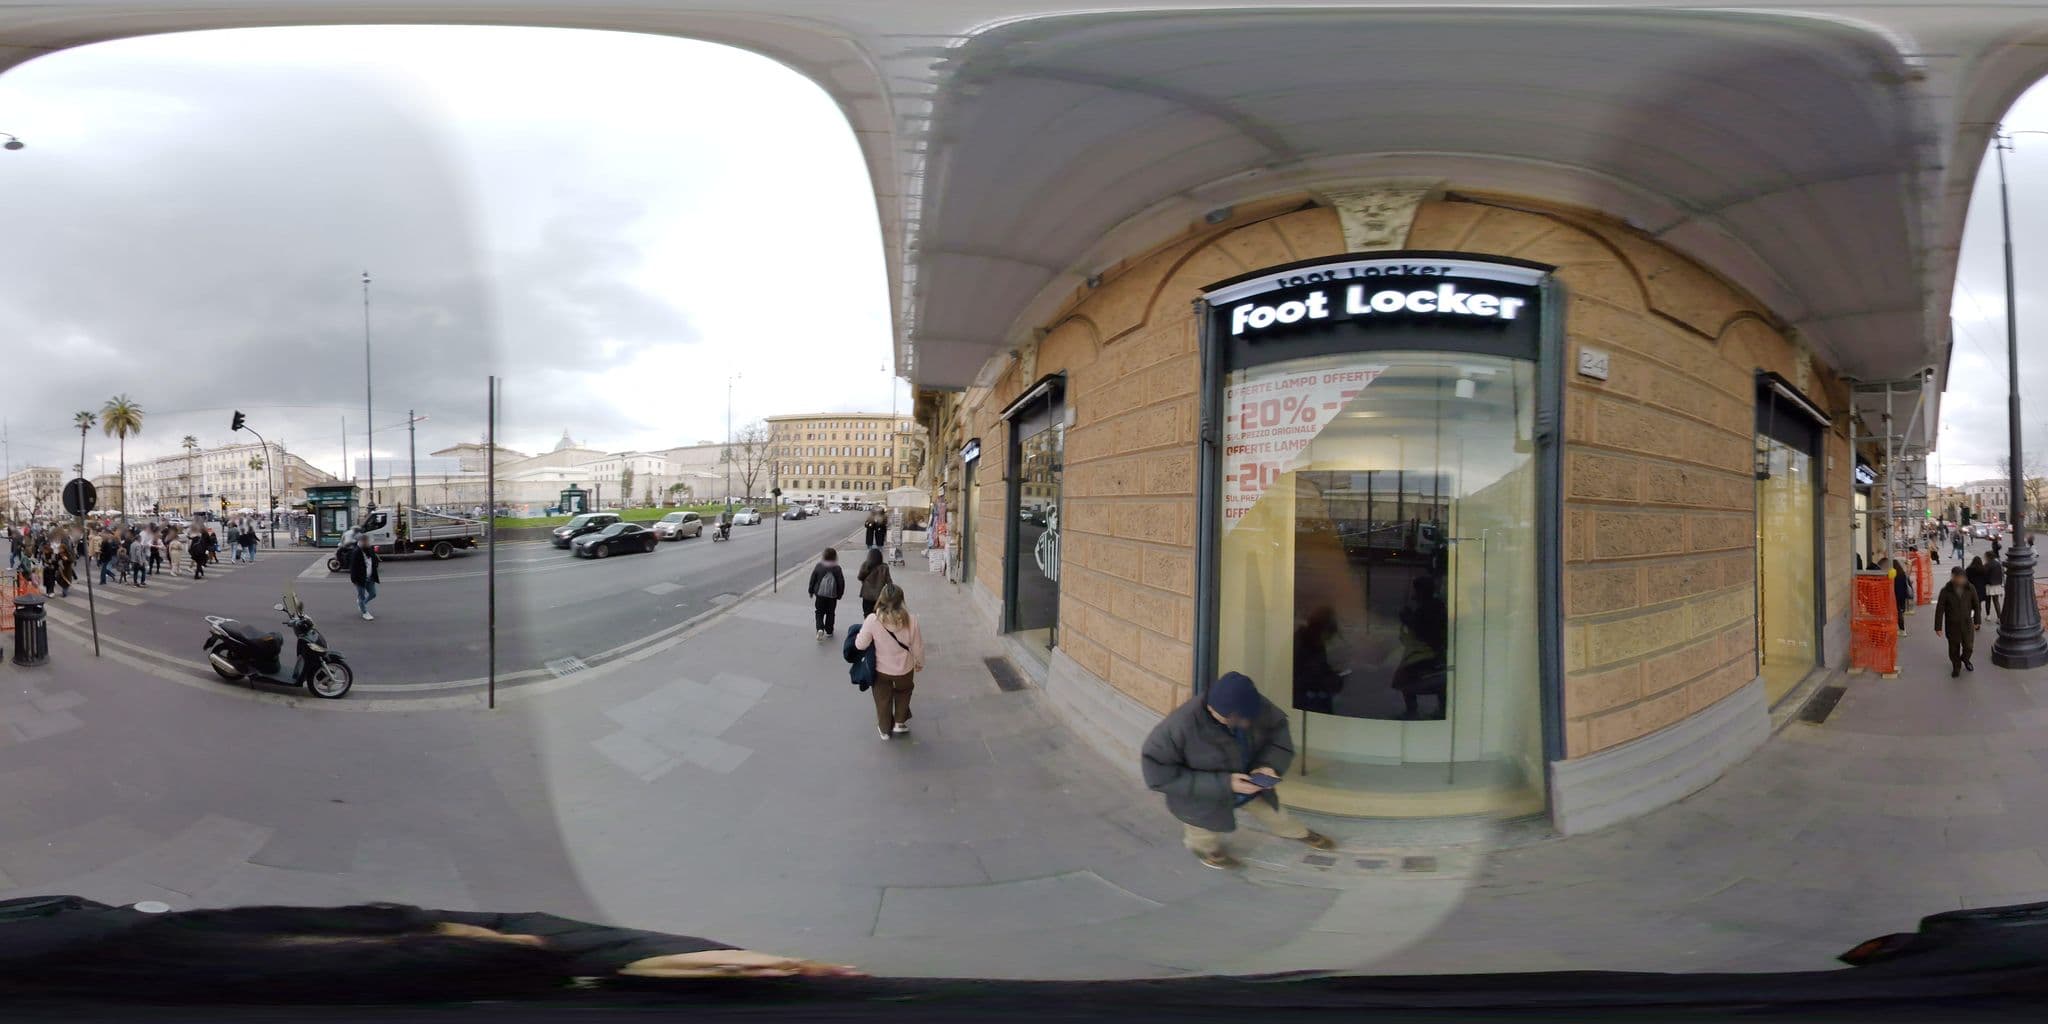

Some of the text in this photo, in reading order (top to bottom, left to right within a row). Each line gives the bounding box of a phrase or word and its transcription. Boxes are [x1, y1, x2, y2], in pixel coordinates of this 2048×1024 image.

[1232, 283, 1524, 335] Foot Locker
[1227, 382, 1273, 399] OFFERTE
[1275, 375, 1317, 391] LAMPO
[1227, 393, 1317, 430] -20%
[1241, 429, 1271, 440] PREZZO
[1272, 424, 1316, 436] ORIGINALE
[1226, 442, 1271, 456] OFFERTE
[1226, 461, 1286, 492] -20
